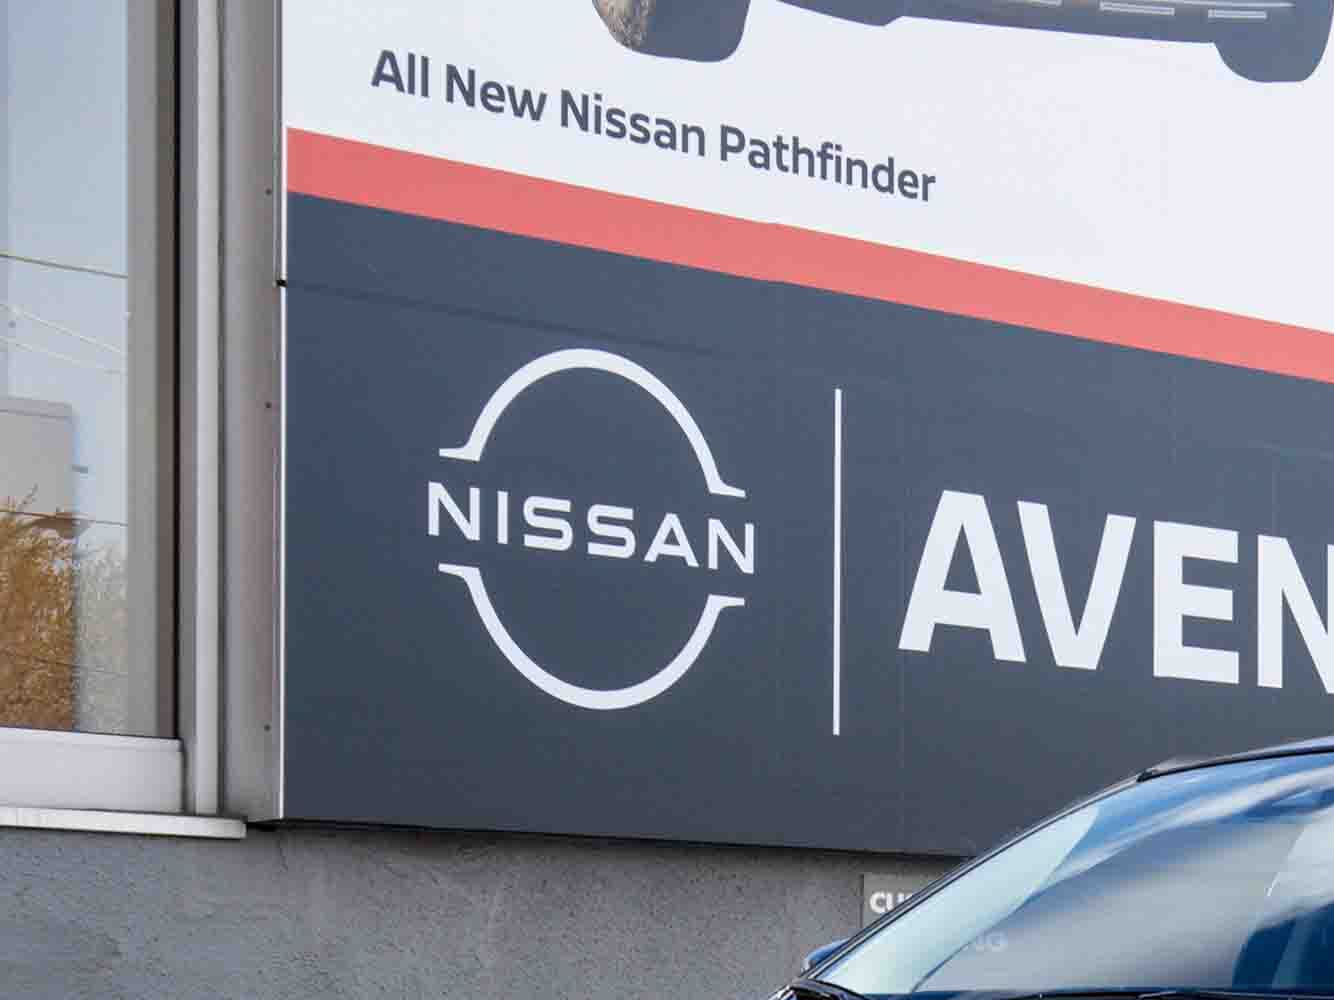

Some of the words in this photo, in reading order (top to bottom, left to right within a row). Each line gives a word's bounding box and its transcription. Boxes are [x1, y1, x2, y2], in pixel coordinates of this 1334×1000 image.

[371, 50, 430, 98] All
[445, 63, 548, 122] New
[560, 89, 706, 157] Nissan
[719, 124, 937, 202] Pathfinder
[428, 481, 755, 574] NISSAN
